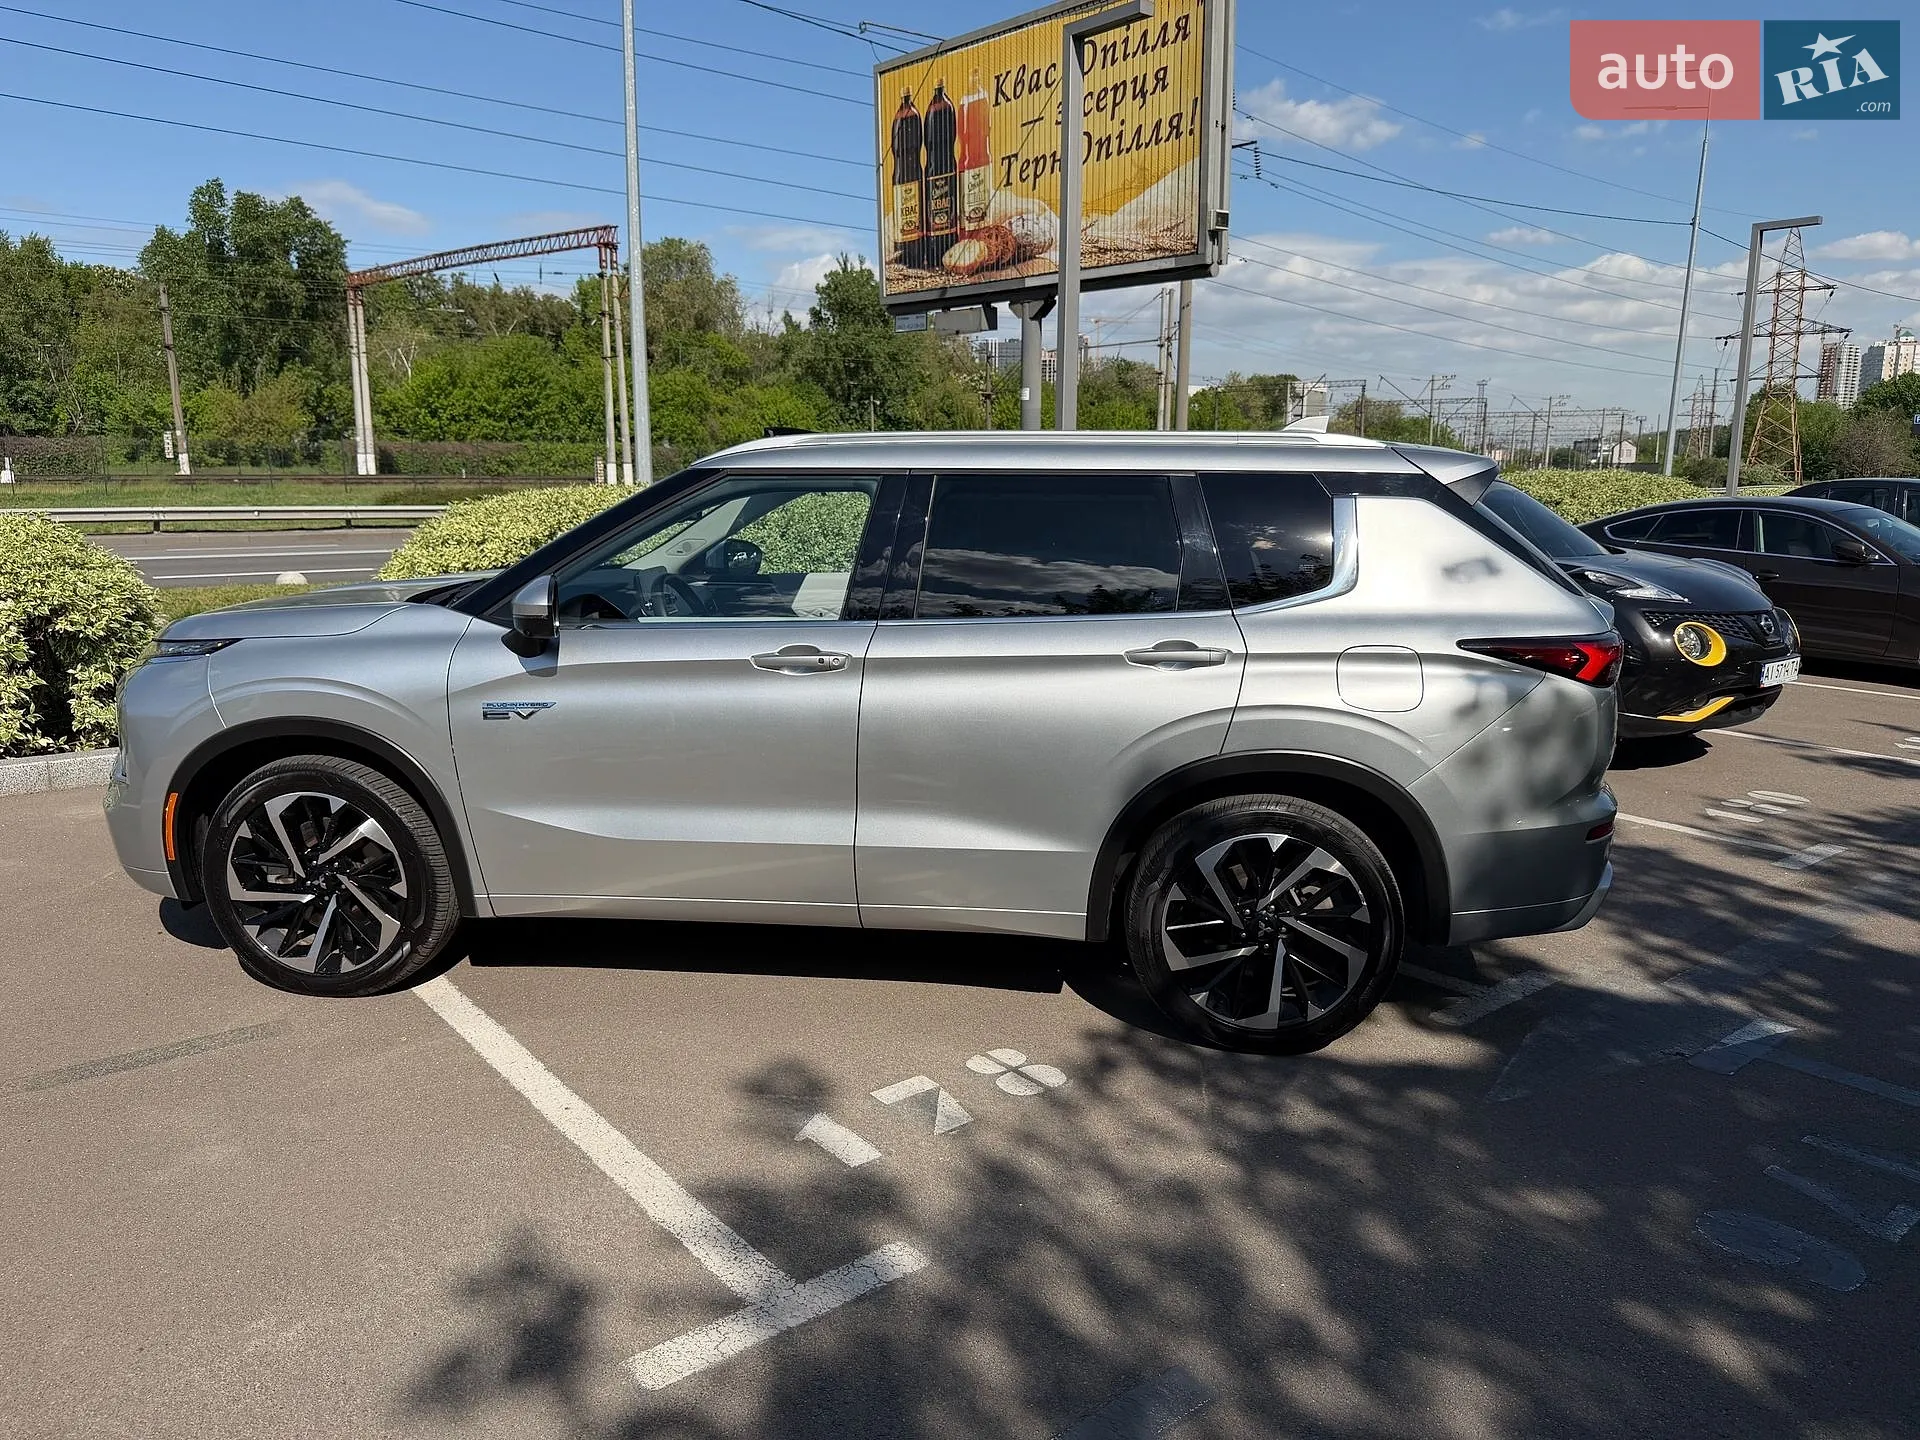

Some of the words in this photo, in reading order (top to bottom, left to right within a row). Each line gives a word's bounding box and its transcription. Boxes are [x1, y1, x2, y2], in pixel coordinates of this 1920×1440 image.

[992, 62, 1057, 107] Квас
[1083, 65, 1169, 121] серця
[482, 709, 542, 720] EV
[794, 1048, 1068, 1168] 178
